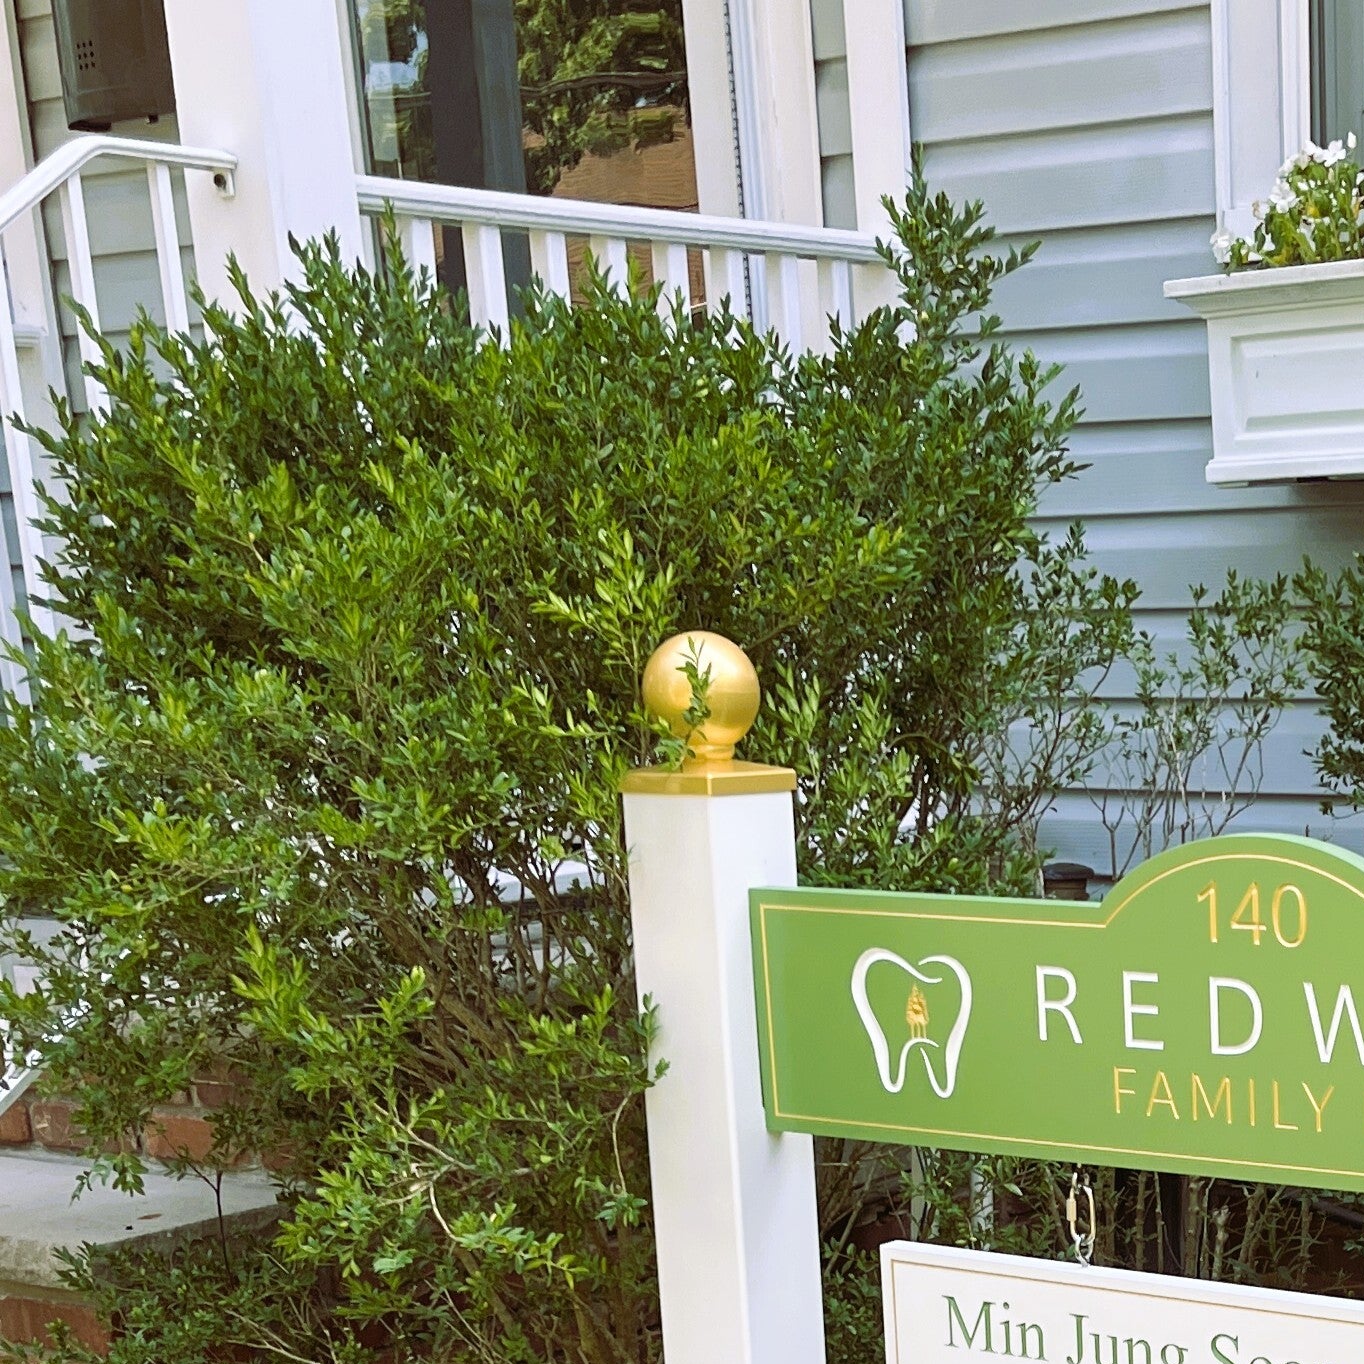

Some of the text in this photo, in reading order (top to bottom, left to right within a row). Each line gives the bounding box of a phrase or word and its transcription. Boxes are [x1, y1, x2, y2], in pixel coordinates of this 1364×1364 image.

[1196, 881, 1308, 949] 140
[1111, 1066, 1335, 1134] FAMILY
[942, 1294, 1048, 1362] Min
